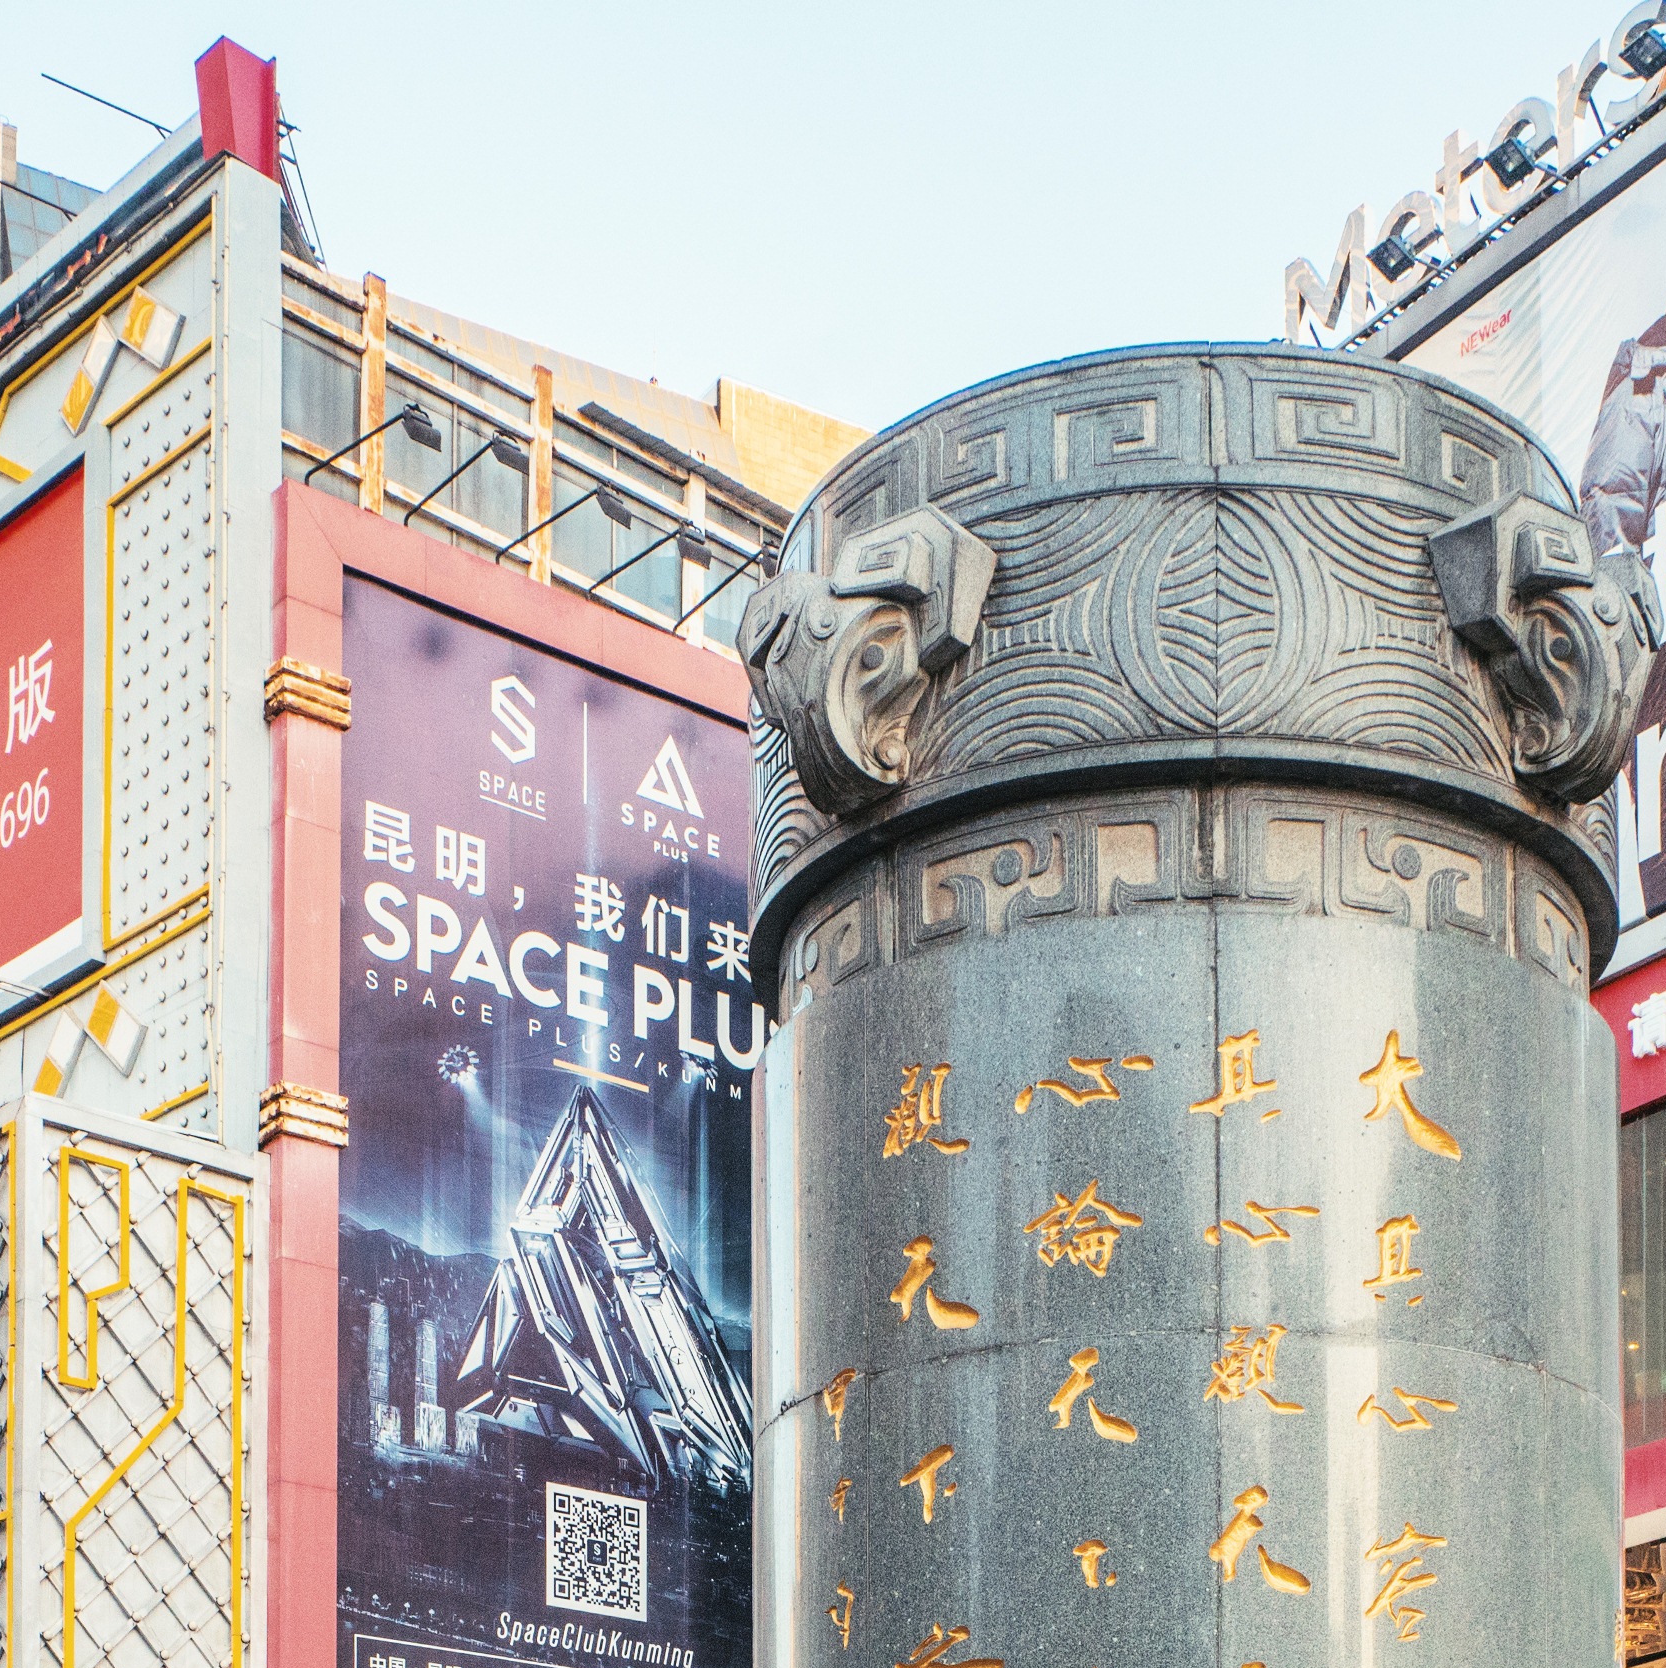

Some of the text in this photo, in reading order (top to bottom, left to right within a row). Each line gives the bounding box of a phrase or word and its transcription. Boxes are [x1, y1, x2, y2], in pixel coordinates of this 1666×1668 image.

[1460, 309, 1513, 357] NEWear
[479, 770, 546, 812] SPACE
[621, 803, 720, 858] SPACE
[653, 842, 689, 863] PLUS
[362, 880, 773, 1070] SPACE PLU
[366, 969, 493, 1025] SPACE
